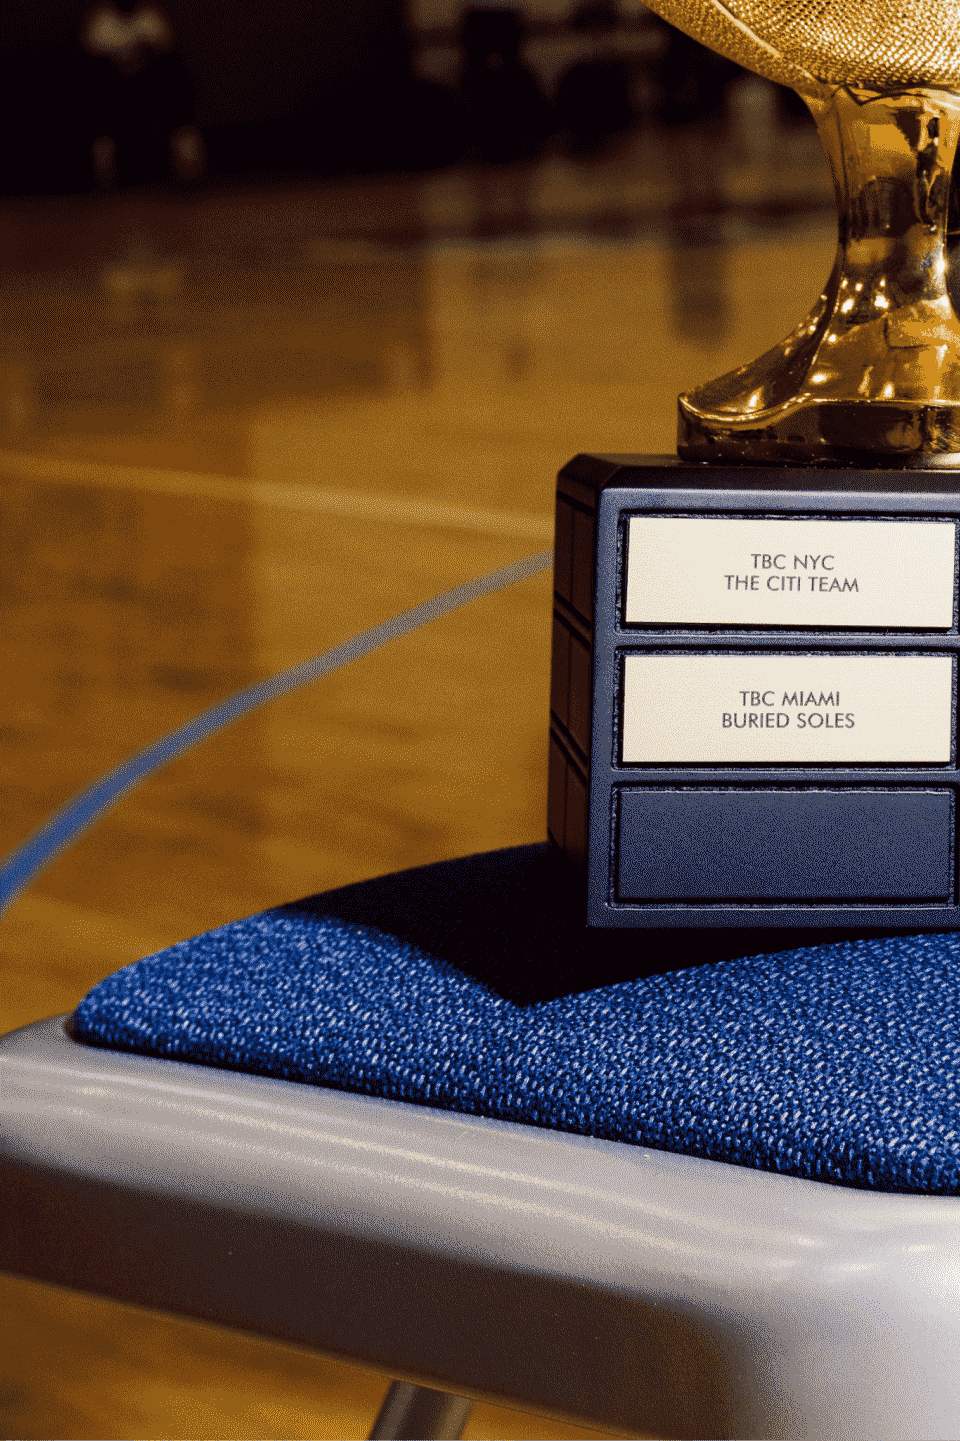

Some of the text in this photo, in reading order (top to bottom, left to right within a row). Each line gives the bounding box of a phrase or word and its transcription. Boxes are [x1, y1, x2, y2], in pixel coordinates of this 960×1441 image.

[751, 553, 835, 571] TBC NYC
[723, 574, 859, 593] THE CITI TEAM
[738, 690, 840, 707] TBC MIAMI
[721, 712, 855, 729] BURIED SOLES
